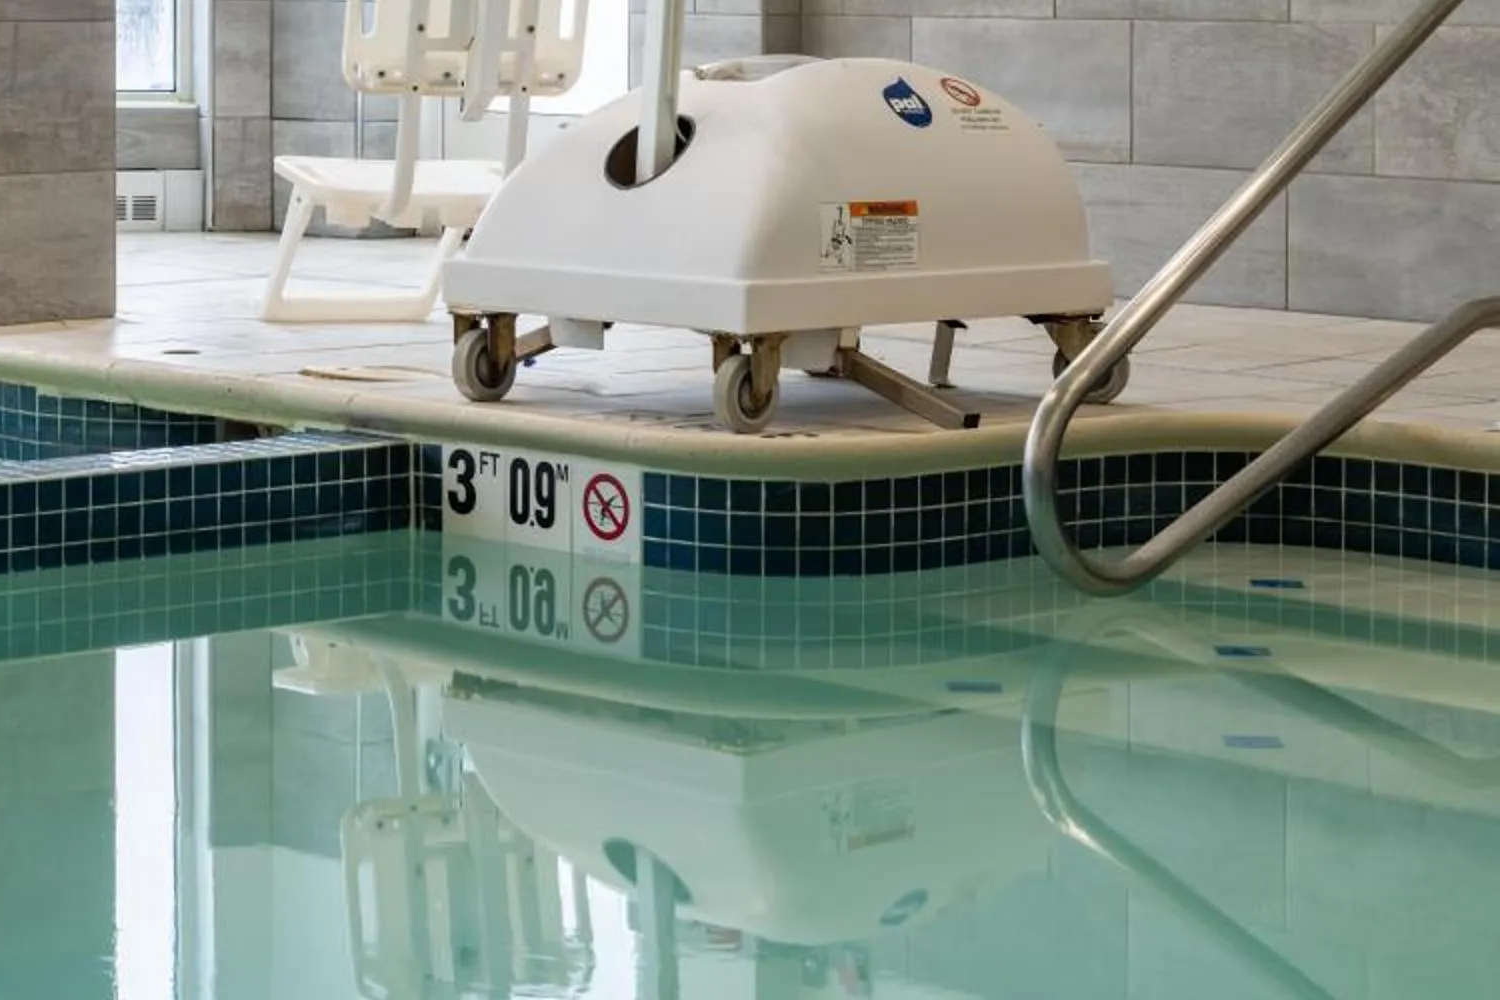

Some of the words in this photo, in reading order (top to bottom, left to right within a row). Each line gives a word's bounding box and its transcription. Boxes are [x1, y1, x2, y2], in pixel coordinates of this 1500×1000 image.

[447, 449, 477, 515] 3
[479, 452, 500, 477] FT
[556, 463, 569, 482] M
